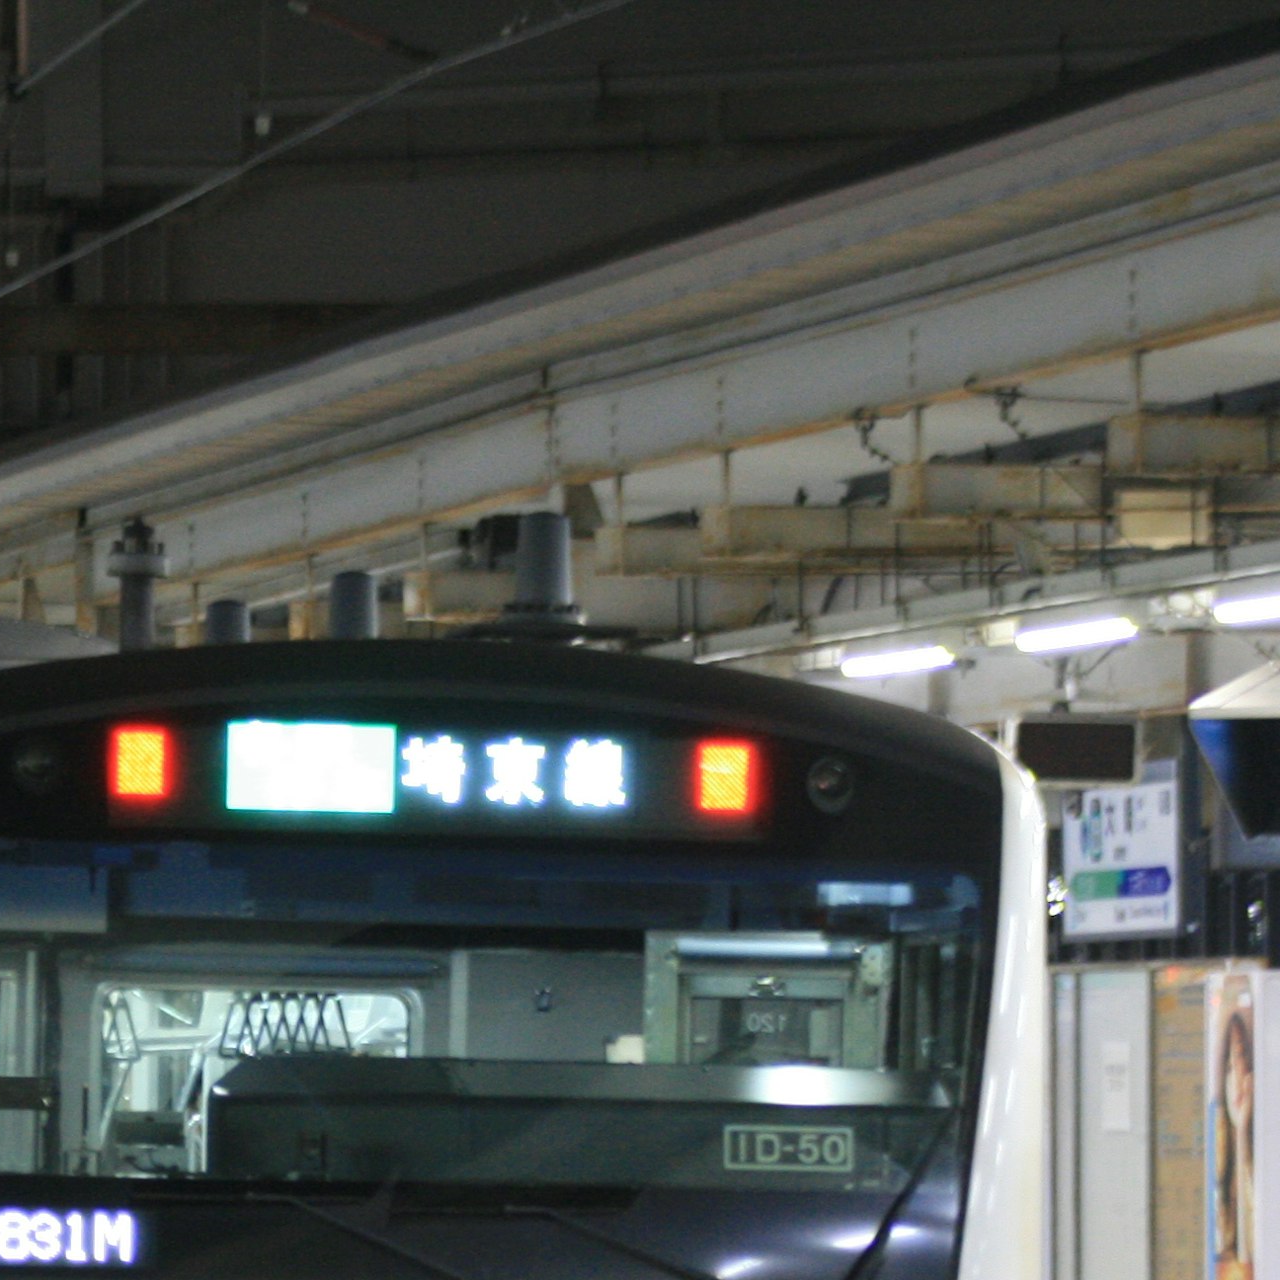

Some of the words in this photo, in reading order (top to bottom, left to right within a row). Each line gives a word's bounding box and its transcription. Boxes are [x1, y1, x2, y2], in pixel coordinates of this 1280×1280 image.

[402, 736, 626, 806] 埼京線
[738, 1132, 846, 1165] ID-50
